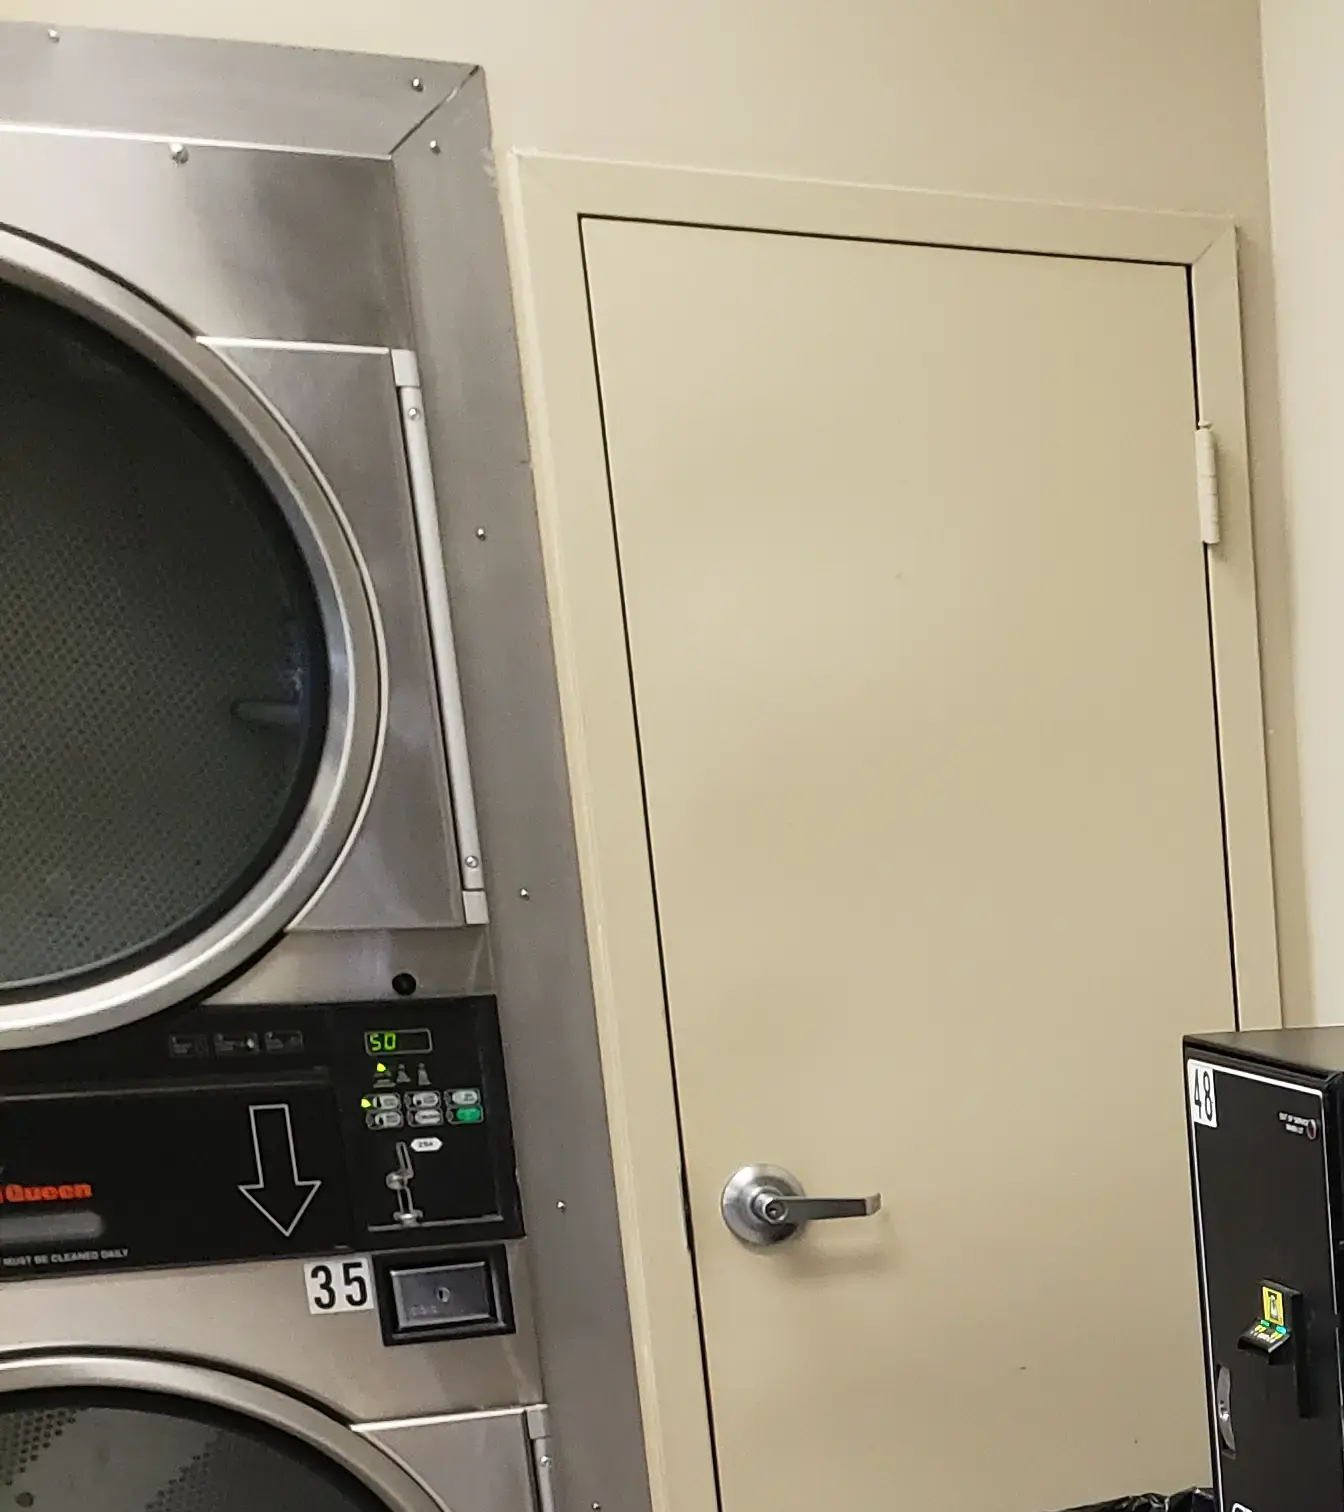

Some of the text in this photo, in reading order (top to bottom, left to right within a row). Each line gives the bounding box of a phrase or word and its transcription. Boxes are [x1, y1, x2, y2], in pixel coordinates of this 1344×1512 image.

[1194, 1068, 1213, 1121] 48
[5, 1183, 92, 1202] Queen
[311, 1262, 368, 1309] 35
